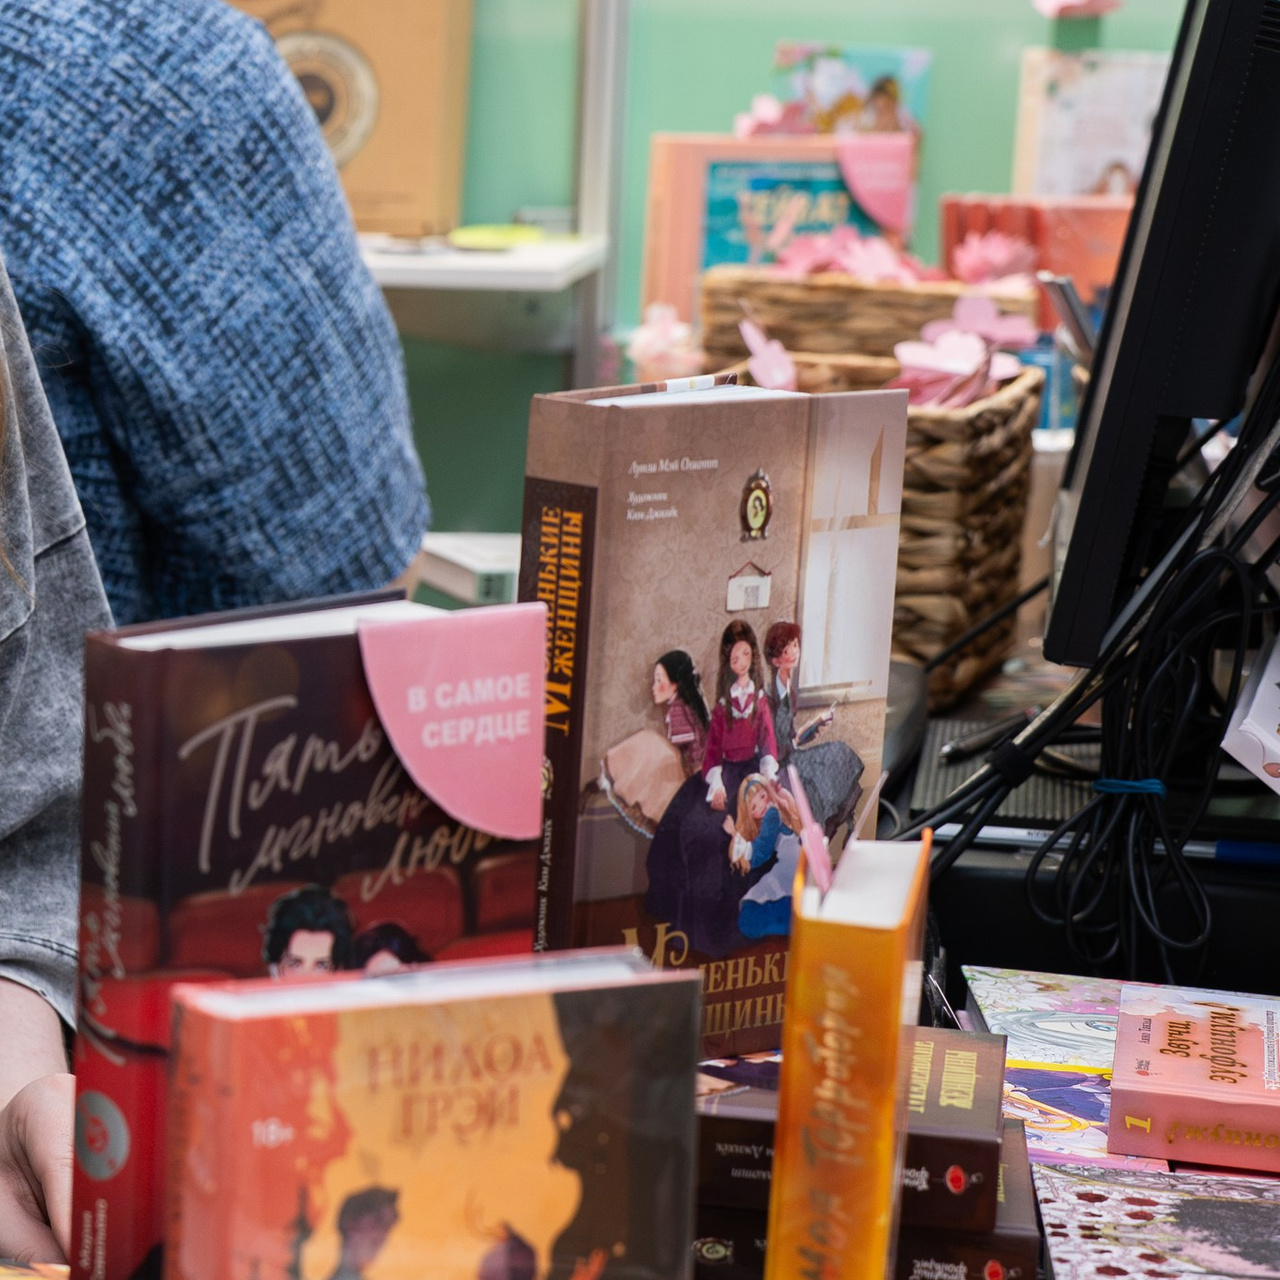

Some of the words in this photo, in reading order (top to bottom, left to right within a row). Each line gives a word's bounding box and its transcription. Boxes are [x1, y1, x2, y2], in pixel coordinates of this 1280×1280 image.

[553, 510, 584, 678] ЖЕНЩИНЫ
[407, 685, 428, 713] В
[435, 672, 532, 709] САМОЕ
[423, 710, 532, 749] СЕРДЦЕ
[178, 695, 382, 874] Пять
[230, 758, 432, 897] мгновен
[1160, 1020, 1198, 1058] Звучи,
[1194, 1001, 1247, 1083] эуфониум!
[1125, 1115, 1152, 1134] 1
